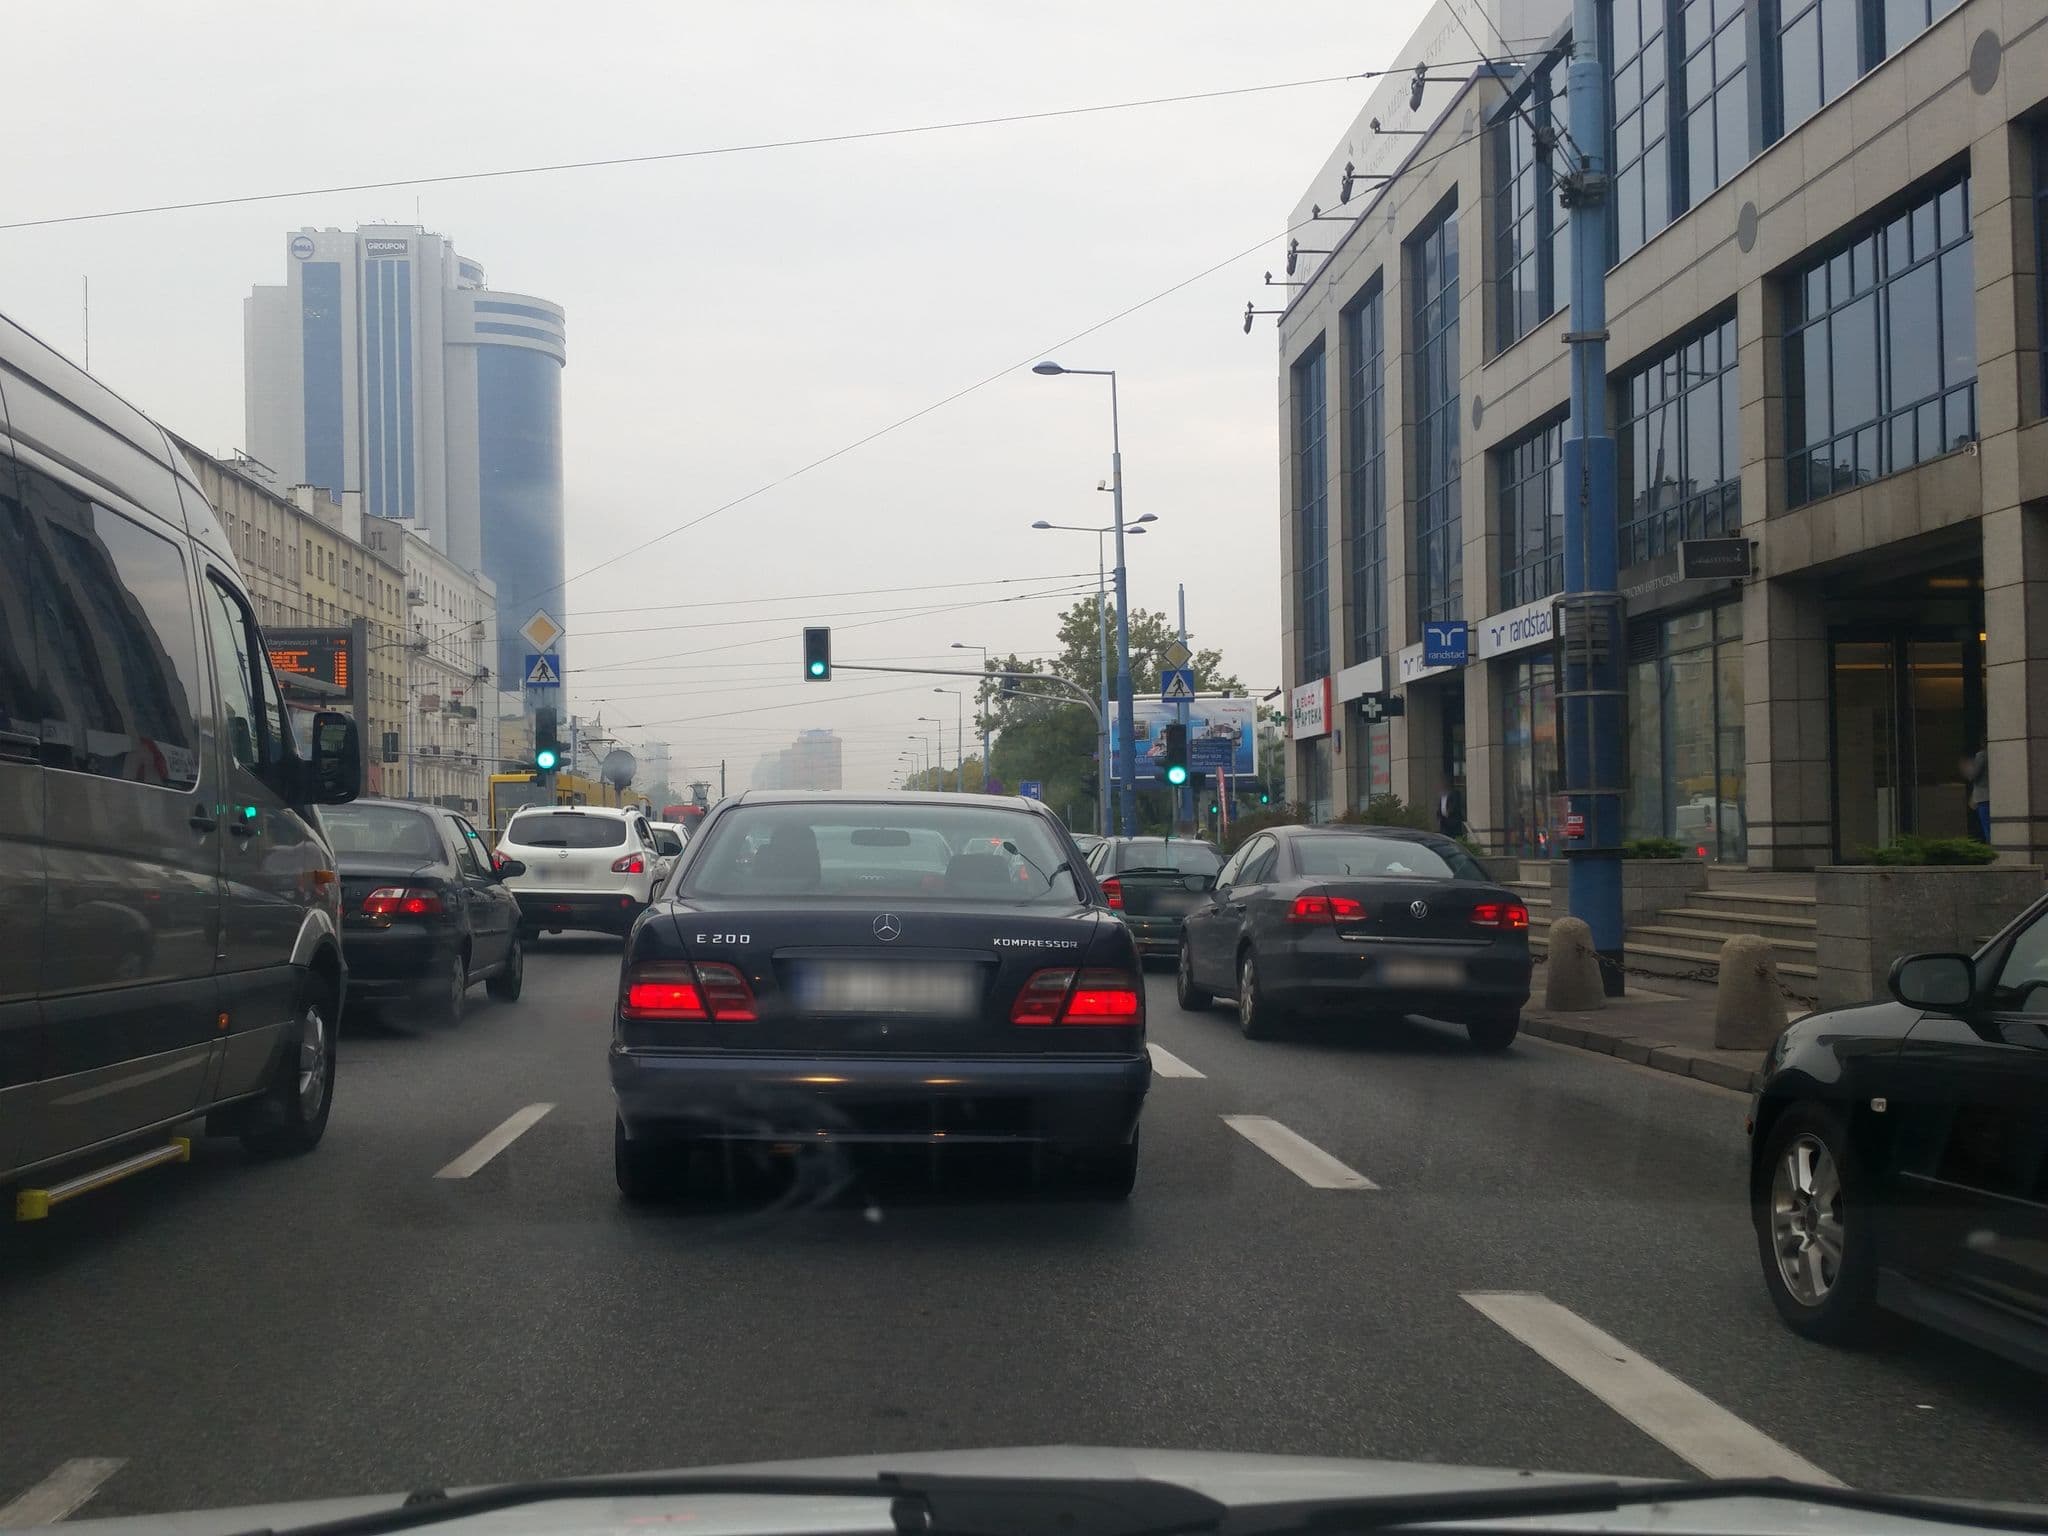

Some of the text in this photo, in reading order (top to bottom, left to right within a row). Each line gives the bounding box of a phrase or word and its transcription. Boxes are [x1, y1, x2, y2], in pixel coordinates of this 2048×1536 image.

[367, 242, 405, 250] GROUPON
[1509, 608, 1552, 643] randstad
[1428, 649, 1465, 660] randstad
[993, 938, 1078, 948] KOMPRESSOR
